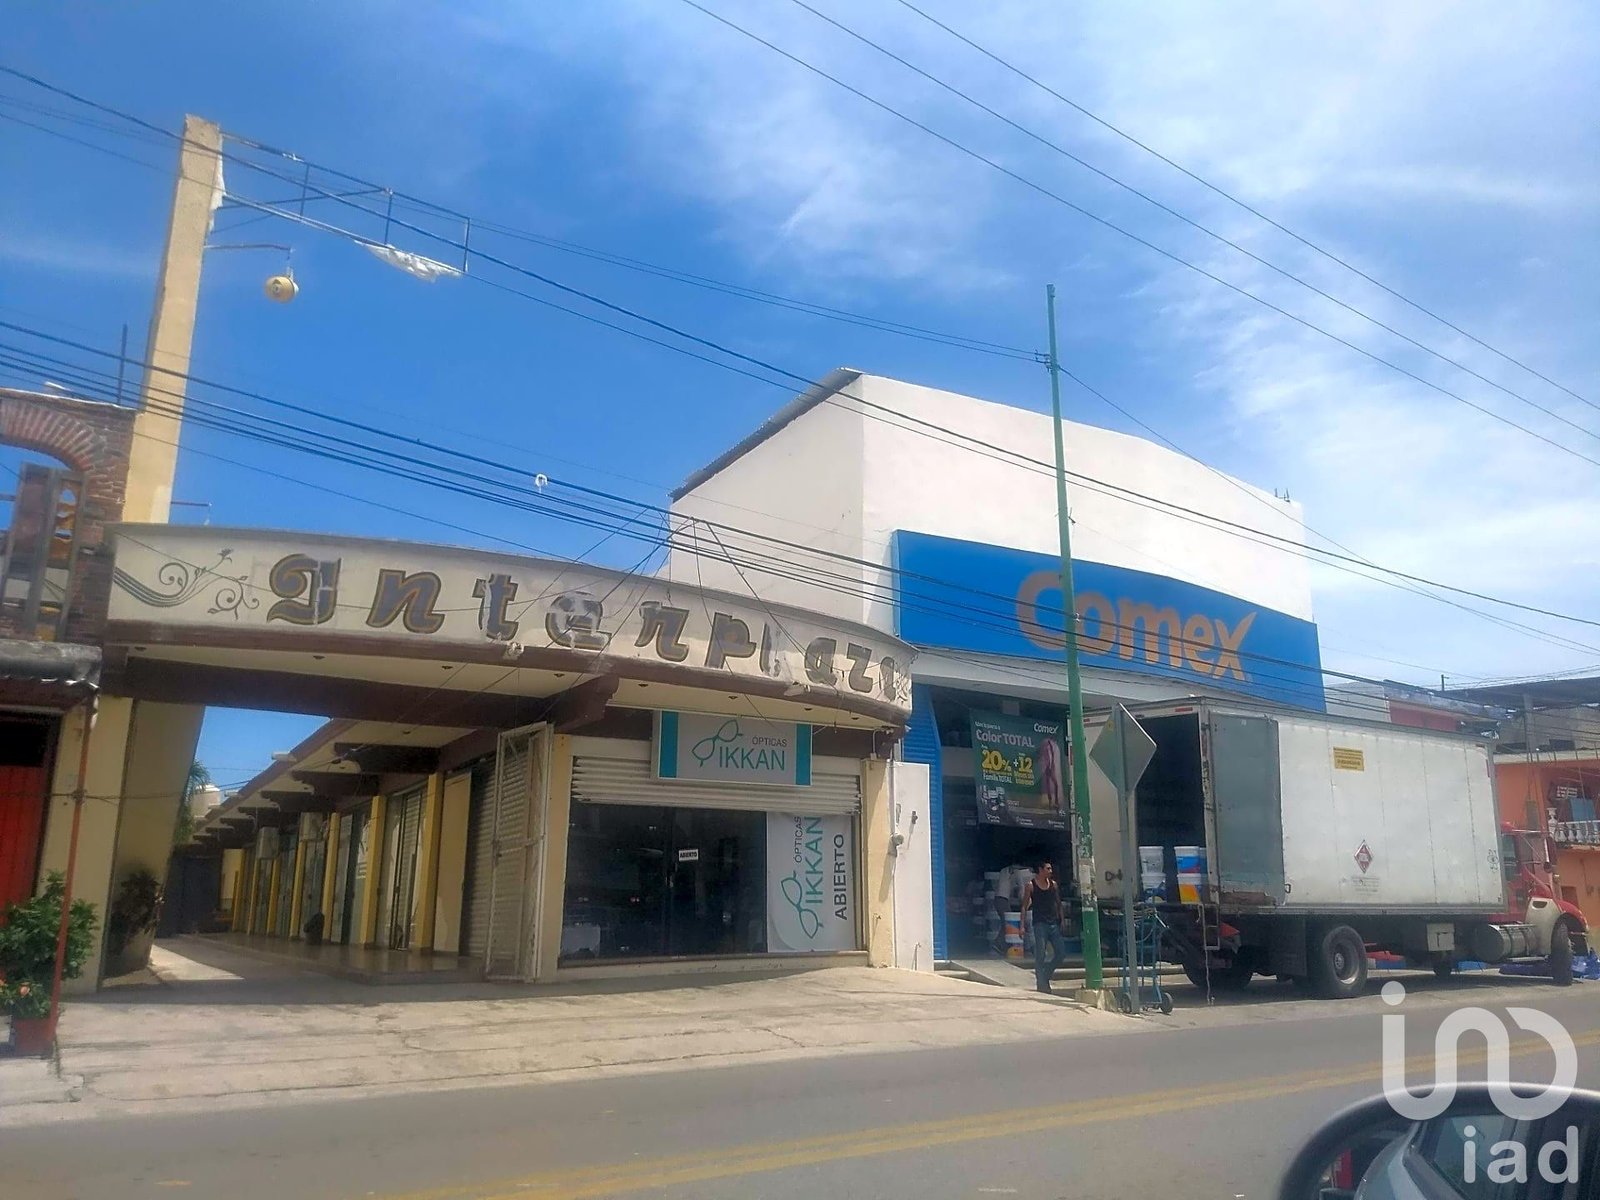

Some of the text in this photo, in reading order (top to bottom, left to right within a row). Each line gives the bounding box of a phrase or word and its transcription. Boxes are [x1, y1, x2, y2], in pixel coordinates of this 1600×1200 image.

[1016, 569, 1257, 681] Comex
[975, 729, 1035, 748] Color TOTAL
[1034, 722, 1059, 734] Comex
[982, 749, 1012, 772] 20%
[804, 816, 823, 904] IKKAN
[833, 834, 847, 920] ABIERTO
